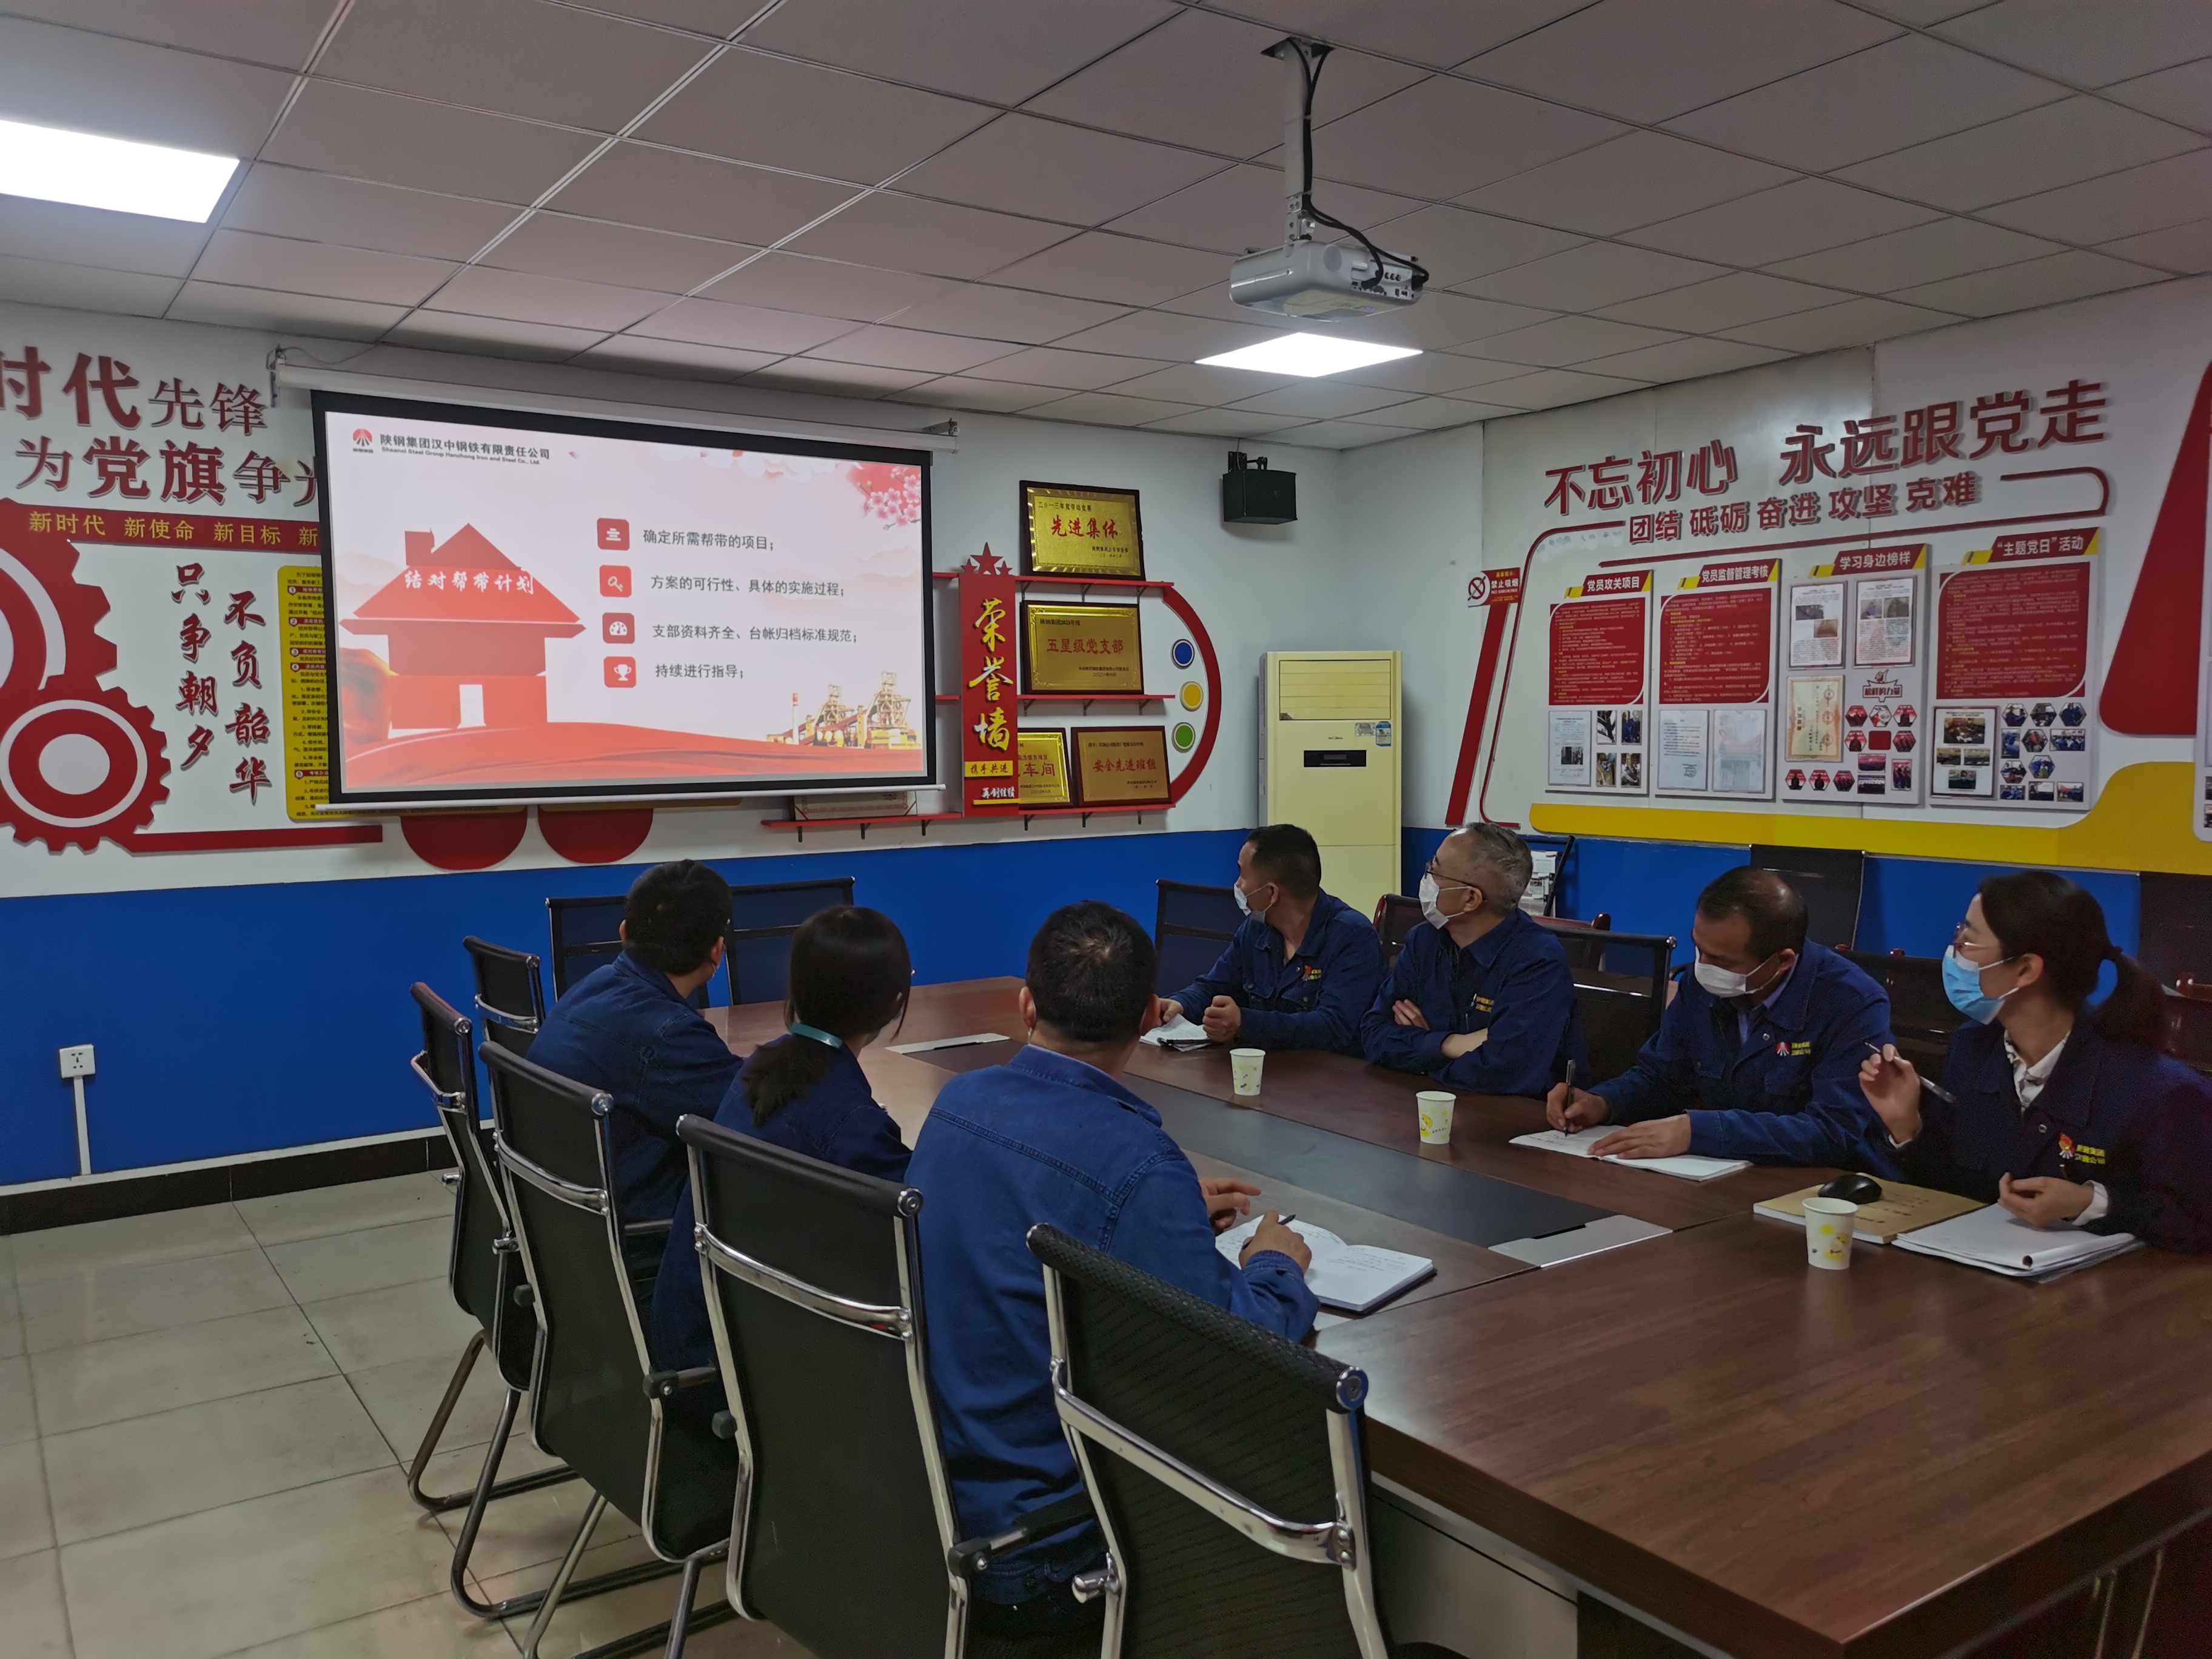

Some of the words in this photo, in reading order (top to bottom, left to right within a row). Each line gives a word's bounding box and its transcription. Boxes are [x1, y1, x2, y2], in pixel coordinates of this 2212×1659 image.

[380, 434, 550, 460] 陕钢集团汉中钢铁有限责任公司
[445, 452, 475, 460] Hanzhong
[1543, 440, 1738, 516] 不忘初心
[1779, 380, 2106, 486] 永远跟党走
[1629, 511, 1683, 545] 团结
[1689, 501, 1751, 537] 砥砺
[1757, 491, 1822, 531] 奋进
[1828, 483, 1898, 521] 攻坚
[1906, 471, 1979, 512] 克难
[29, 511, 106, 537] 新时代
[123, 517, 195, 541] 新使命
[213, 521, 281, 545] 新目标
[1051, 514, 1119, 539] 先进集体
[643, 529, 774, 551] 确定所需帮带的项目；
[1997, 535, 2084, 557] “主题党日”活动
[1839, 551, 1911, 571] 学习身边榜样
[404, 571, 535, 595] 结对帮带计划
[1491, 578, 1518, 589] 禁止吸烟
[1587, 576, 1640, 592] 党员攻关项目
[1701, 564, 1769, 584] 党员监督管理考核
[651, 575, 845, 597] 方案的可行性、具体的实施过程；
[1047, 638, 1124, 655] 五星级党支部
[170, 562, 219, 772] 只争朝夕
[655, 664, 744, 680] 持续进行指导；
[968, 598, 1014, 752] 荣誉墙
[223, 591, 273, 805] 不负韶华
[970, 763, 1008, 775] 携手共进
[1093, 758, 1157, 773] 安全先进班组
[982, 786, 1015, 799] 再创佳绩
